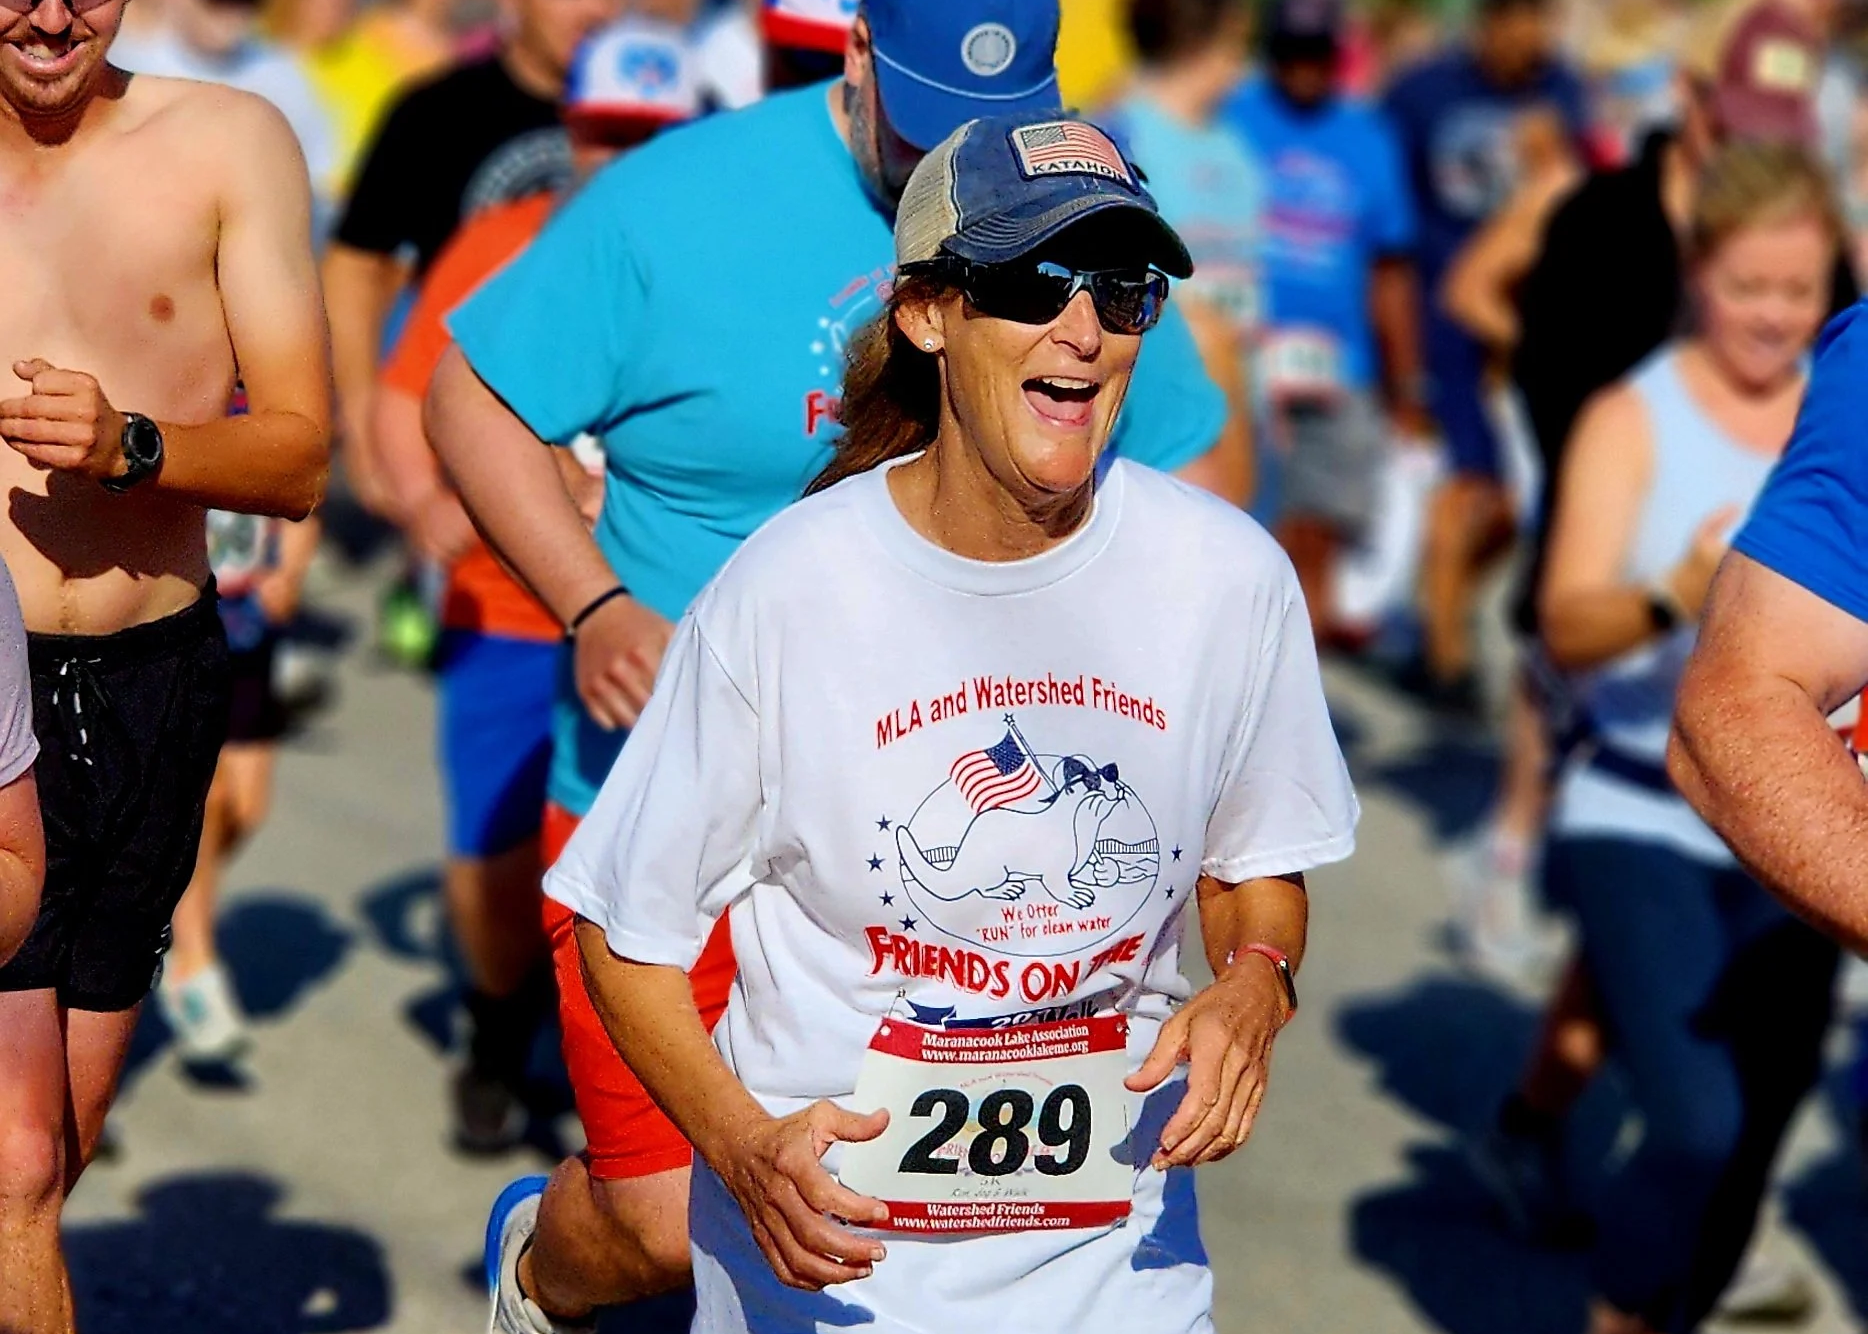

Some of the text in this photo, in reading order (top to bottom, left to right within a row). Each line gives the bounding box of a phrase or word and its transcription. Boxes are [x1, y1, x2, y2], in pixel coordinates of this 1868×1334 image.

[876, 672, 1167, 749] MLA and Watershed Friends
[1001, 905, 1023, 923] We
[1020, 922, 1037, 939] for
[1043, 920, 1074, 935] clean
[1077, 915, 1112, 931] water
[864, 926, 1011, 1002] FRIENDS
[1018, 959, 1081, 1004] ON
[921, 1025, 1090, 1048] Maranacook Lake Association
[921, 1040, 1089, 1062] www.maranacooklakeme.org
[897, 1083, 1092, 1176] 289
[926, 1202, 1046, 1217] Watershed Friends
[892, 1215, 1071, 1230] www.watershedfriends.com
